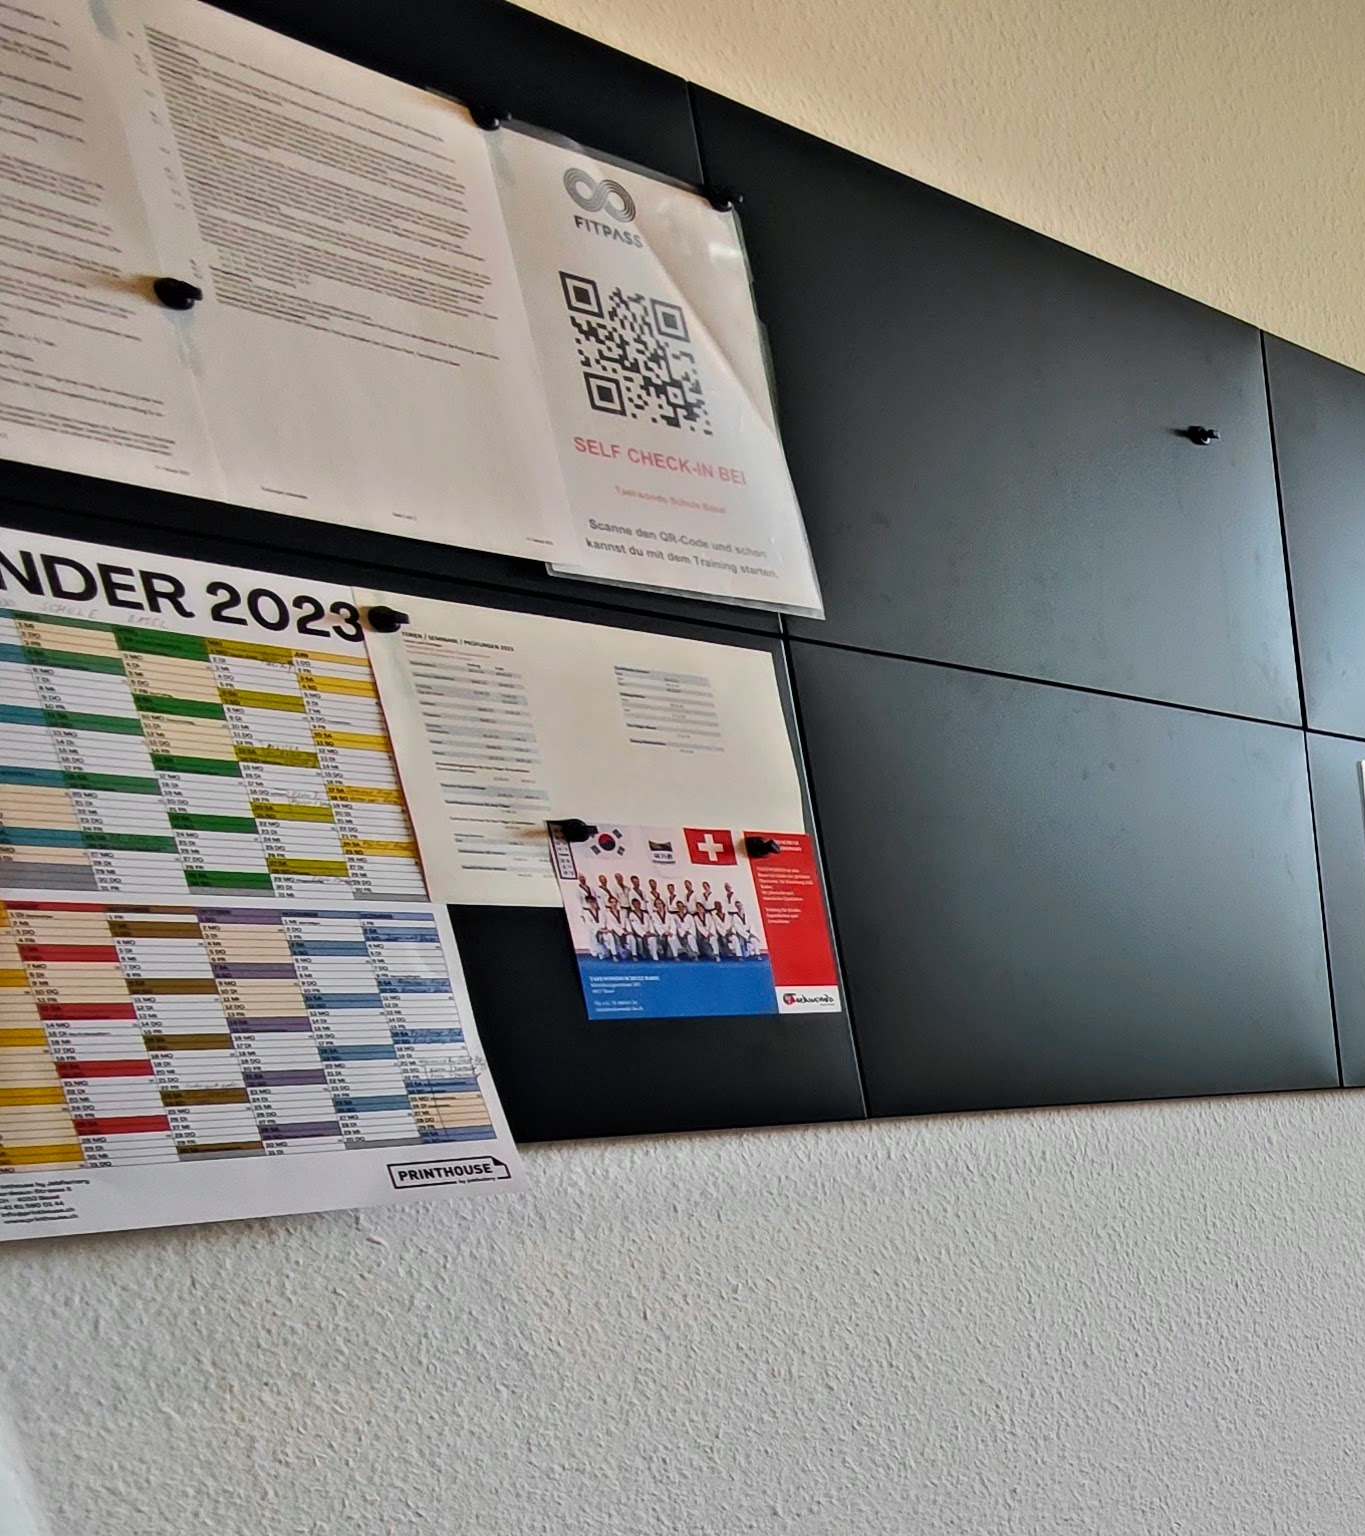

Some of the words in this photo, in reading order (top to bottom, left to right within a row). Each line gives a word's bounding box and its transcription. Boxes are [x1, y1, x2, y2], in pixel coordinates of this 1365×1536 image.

[574, 215, 643, 248] FITPASS
[573, 436, 620, 459] SELF
[627, 448, 714, 478] CHECK-IN
[718, 466, 747, 485] BEI
[585, 537, 626, 555] kannst
[629, 545, 644, 557] du
[646, 549, 665, 561] mit
[668, 552, 691, 564] dem
[693, 555, 738, 574] Training
[740, 564, 780, 579] starten.
[588, 519, 633, 536] Scanne
[635, 528, 657, 541] den
[659, 531, 710, 550] QR-Code
[711, 541, 732, 553] und
[735, 546, 767, 559] schon
[205, 580, 366, 643] 2023
[398, 1164, 493, 1181] PRINTHOUSE
